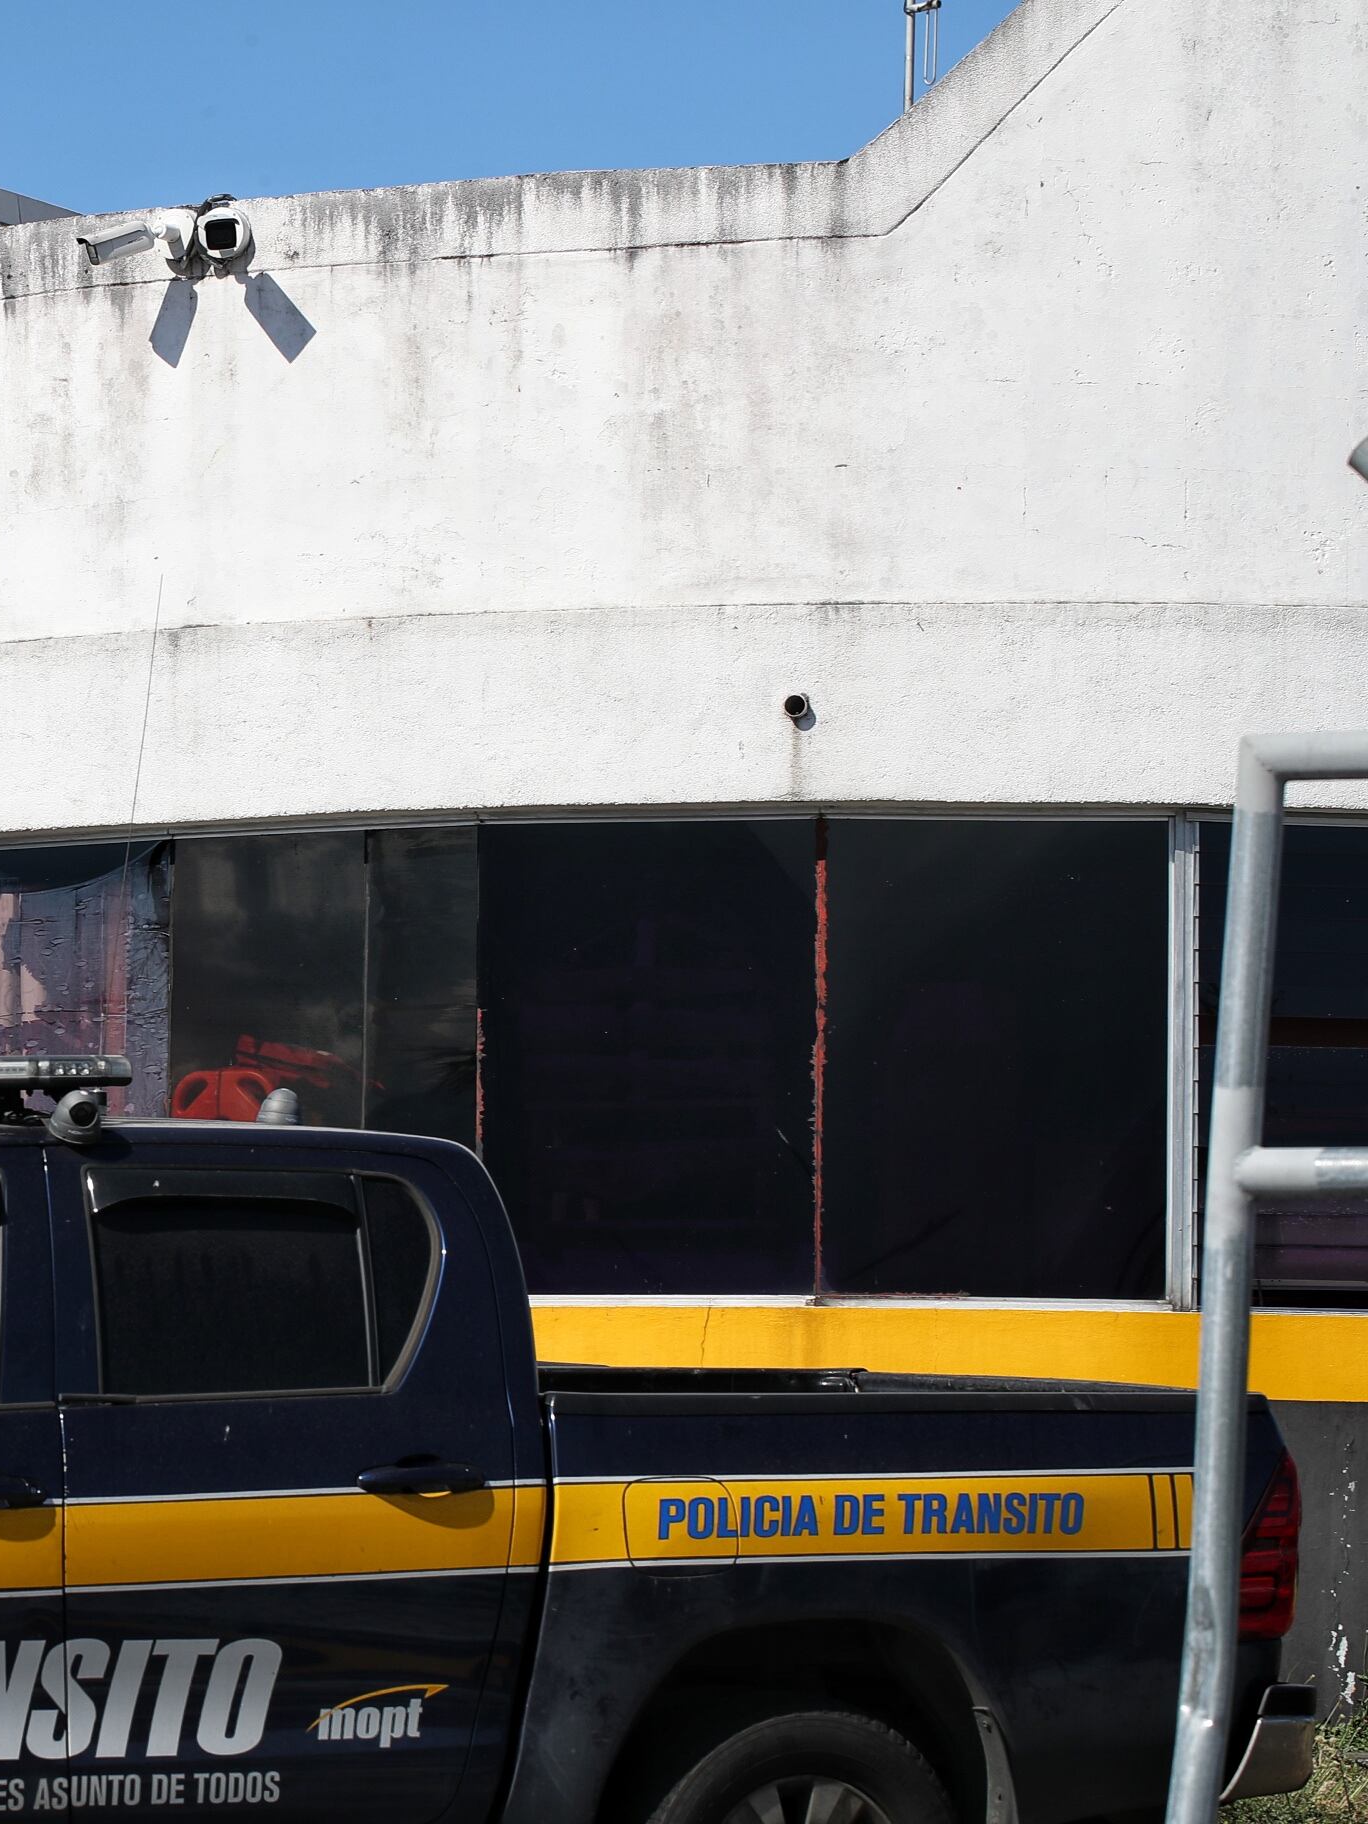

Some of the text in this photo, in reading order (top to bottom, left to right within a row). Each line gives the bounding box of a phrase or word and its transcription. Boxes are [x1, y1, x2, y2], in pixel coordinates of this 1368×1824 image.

[658, 1492, 1084, 1541] POLICIA DE TRANSITO
[317, 1698, 423, 1748] mopt
[34, 1774, 141, 1810] ASUNTO
[151, 1773, 185, 1805] DE
[194, 1771, 281, 1804] TODOS
